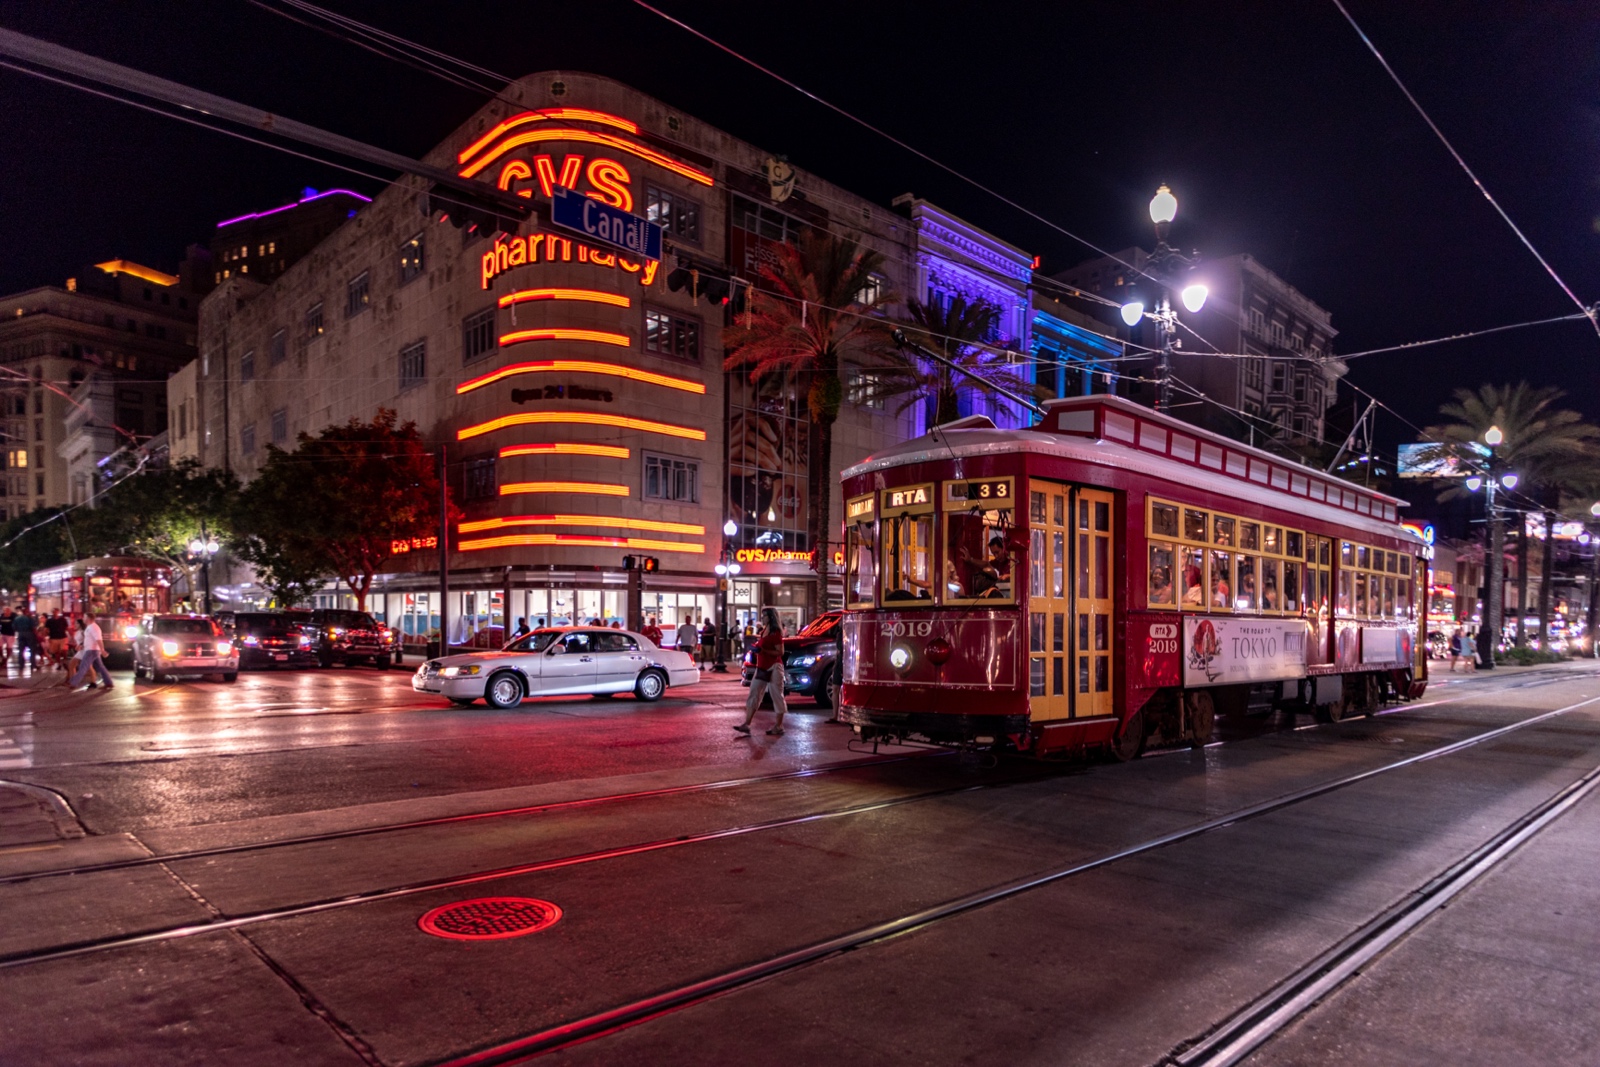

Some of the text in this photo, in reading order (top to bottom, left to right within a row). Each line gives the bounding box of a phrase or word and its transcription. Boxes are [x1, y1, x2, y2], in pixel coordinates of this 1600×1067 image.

[498, 153, 633, 213] CVS
[583, 200, 645, 253] Canal
[892, 488, 927, 506] RTA
[881, 621, 932, 637] 2019
[1154, 626, 1167, 636] RTA
[1239, 627, 1250, 635] THE
[1149, 639, 1178, 653] 2019
[1232, 637, 1277, 659] TOKYO
